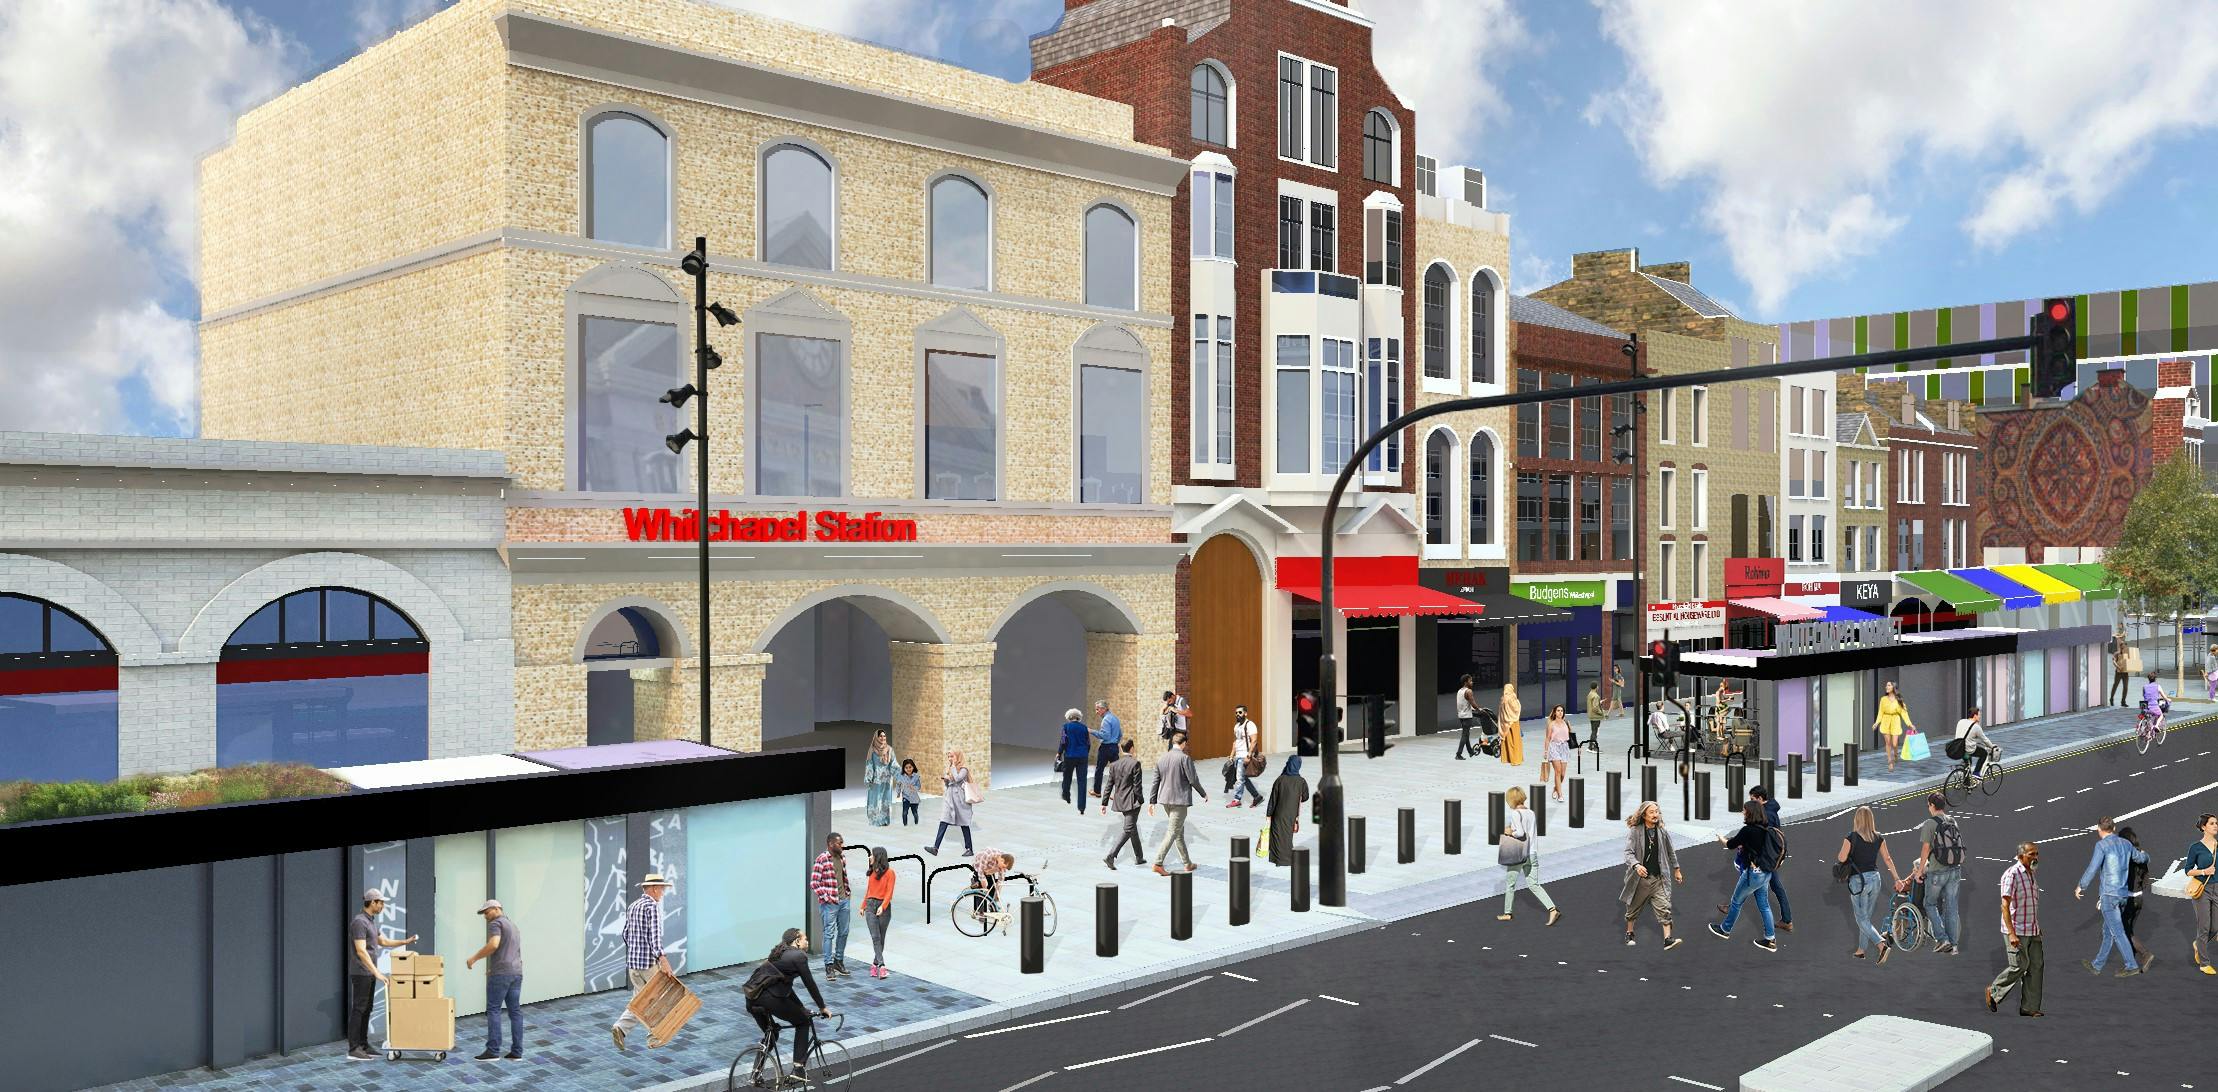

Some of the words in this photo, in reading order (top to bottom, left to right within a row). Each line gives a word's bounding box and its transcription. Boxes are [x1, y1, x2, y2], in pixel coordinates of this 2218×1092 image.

[623, 507, 807, 542] Whitchapel
[815, 511, 917, 541] Station
[1529, 585, 1569, 602] Budgens
[1856, 583, 1879, 600] KEYA
